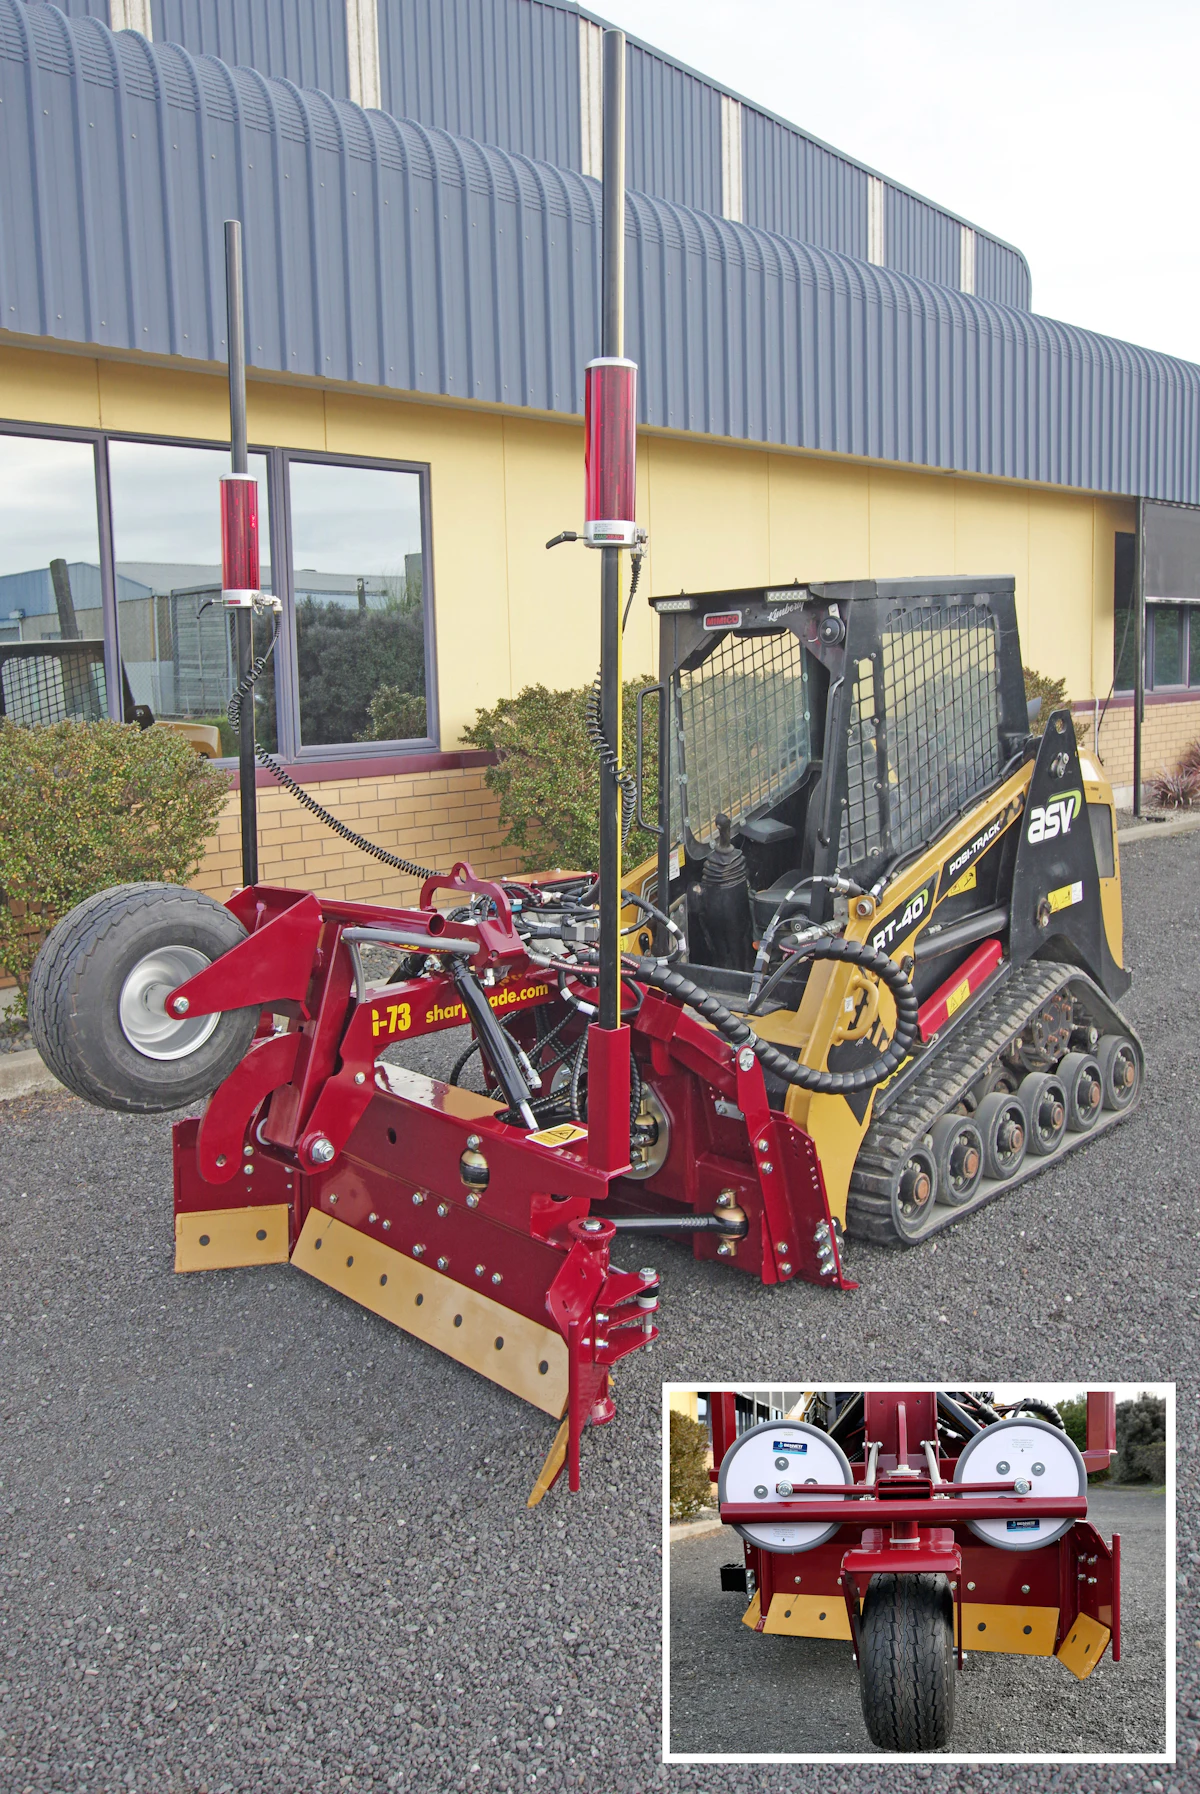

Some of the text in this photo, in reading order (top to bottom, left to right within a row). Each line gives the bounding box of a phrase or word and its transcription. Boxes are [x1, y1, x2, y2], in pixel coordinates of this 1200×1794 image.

[706, 614, 739, 627] MIMICO
[949, 821, 1000, 875] POSI-TRACK
[873, 897, 923, 952] RT-40
